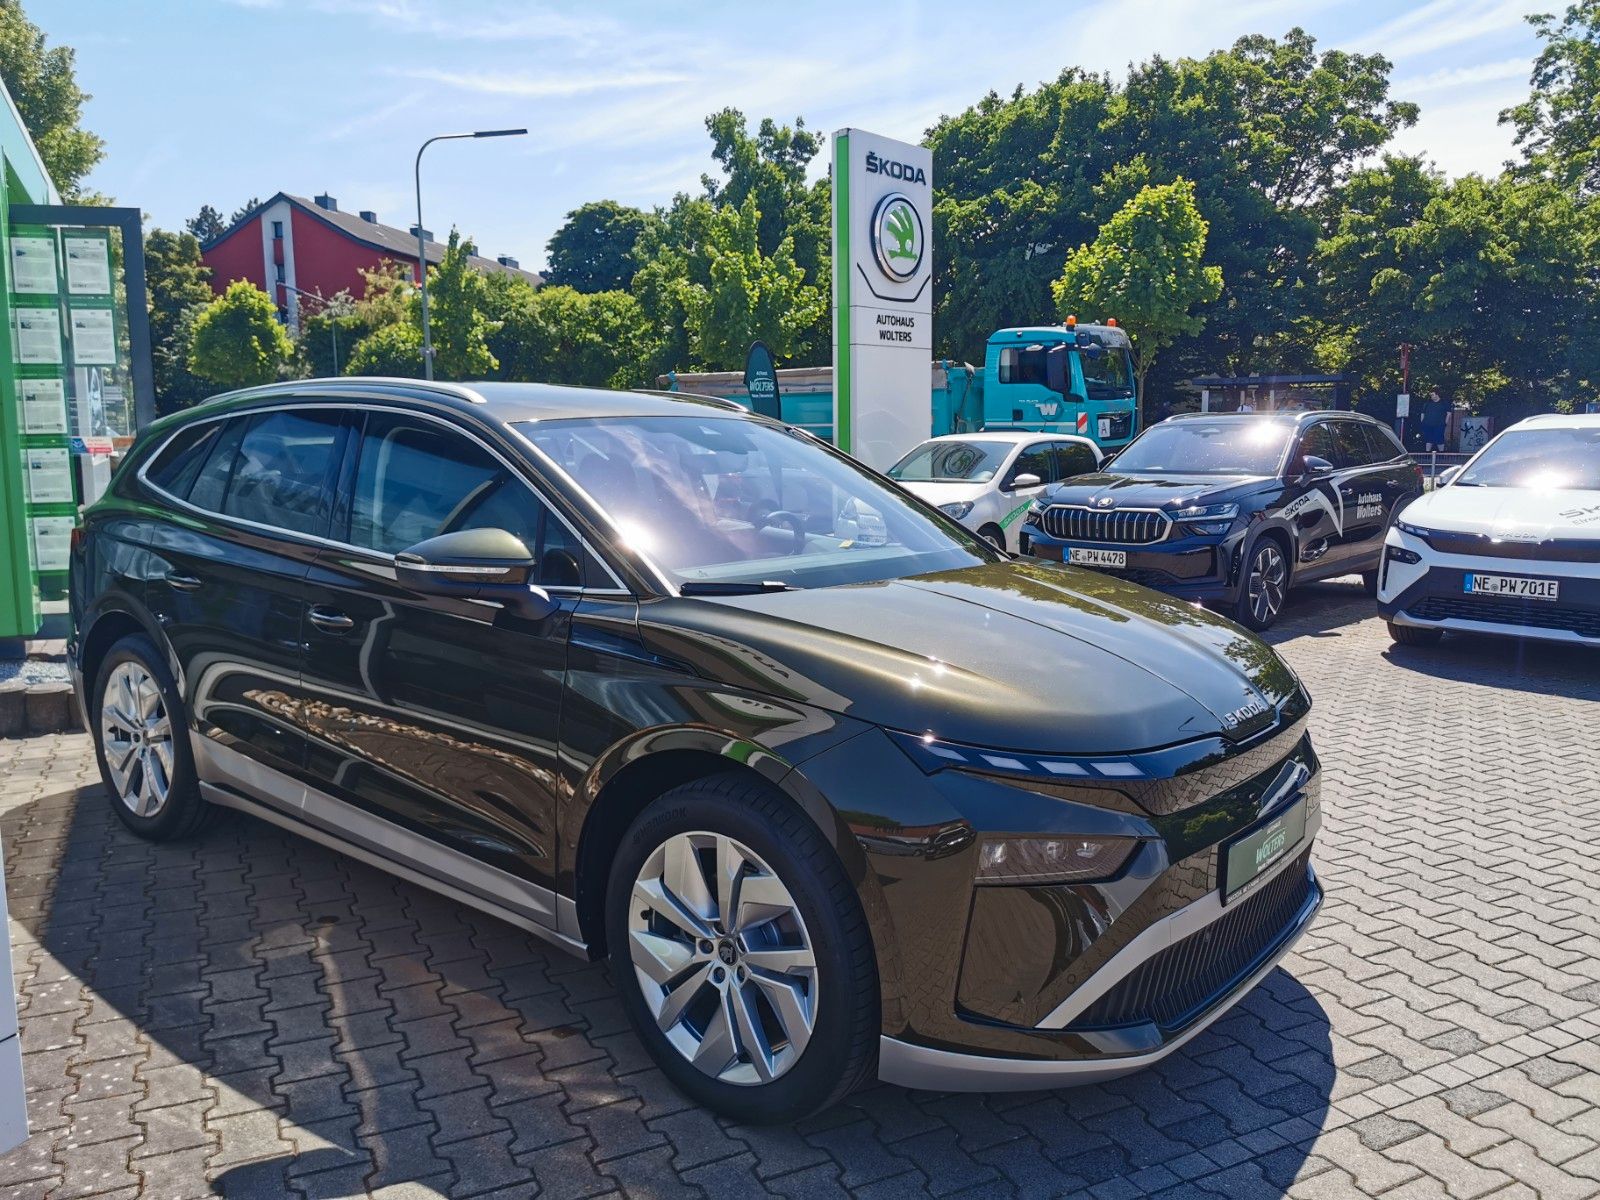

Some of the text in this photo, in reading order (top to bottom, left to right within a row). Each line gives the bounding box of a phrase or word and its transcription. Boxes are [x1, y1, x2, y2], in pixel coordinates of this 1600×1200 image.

[866, 151, 926, 186] ŠKODA
[876, 314, 914, 327] AUTOHAUS
[879, 329, 912, 342] WOLTERS
[1358, 493, 1382, 505] Autohaus
[1070, 550, 1125, 564] NE PW 4478
[1473, 576, 1490, 590] NE
[1500, 579, 1517, 593] PW
[1520, 580, 1556, 596] 701E
